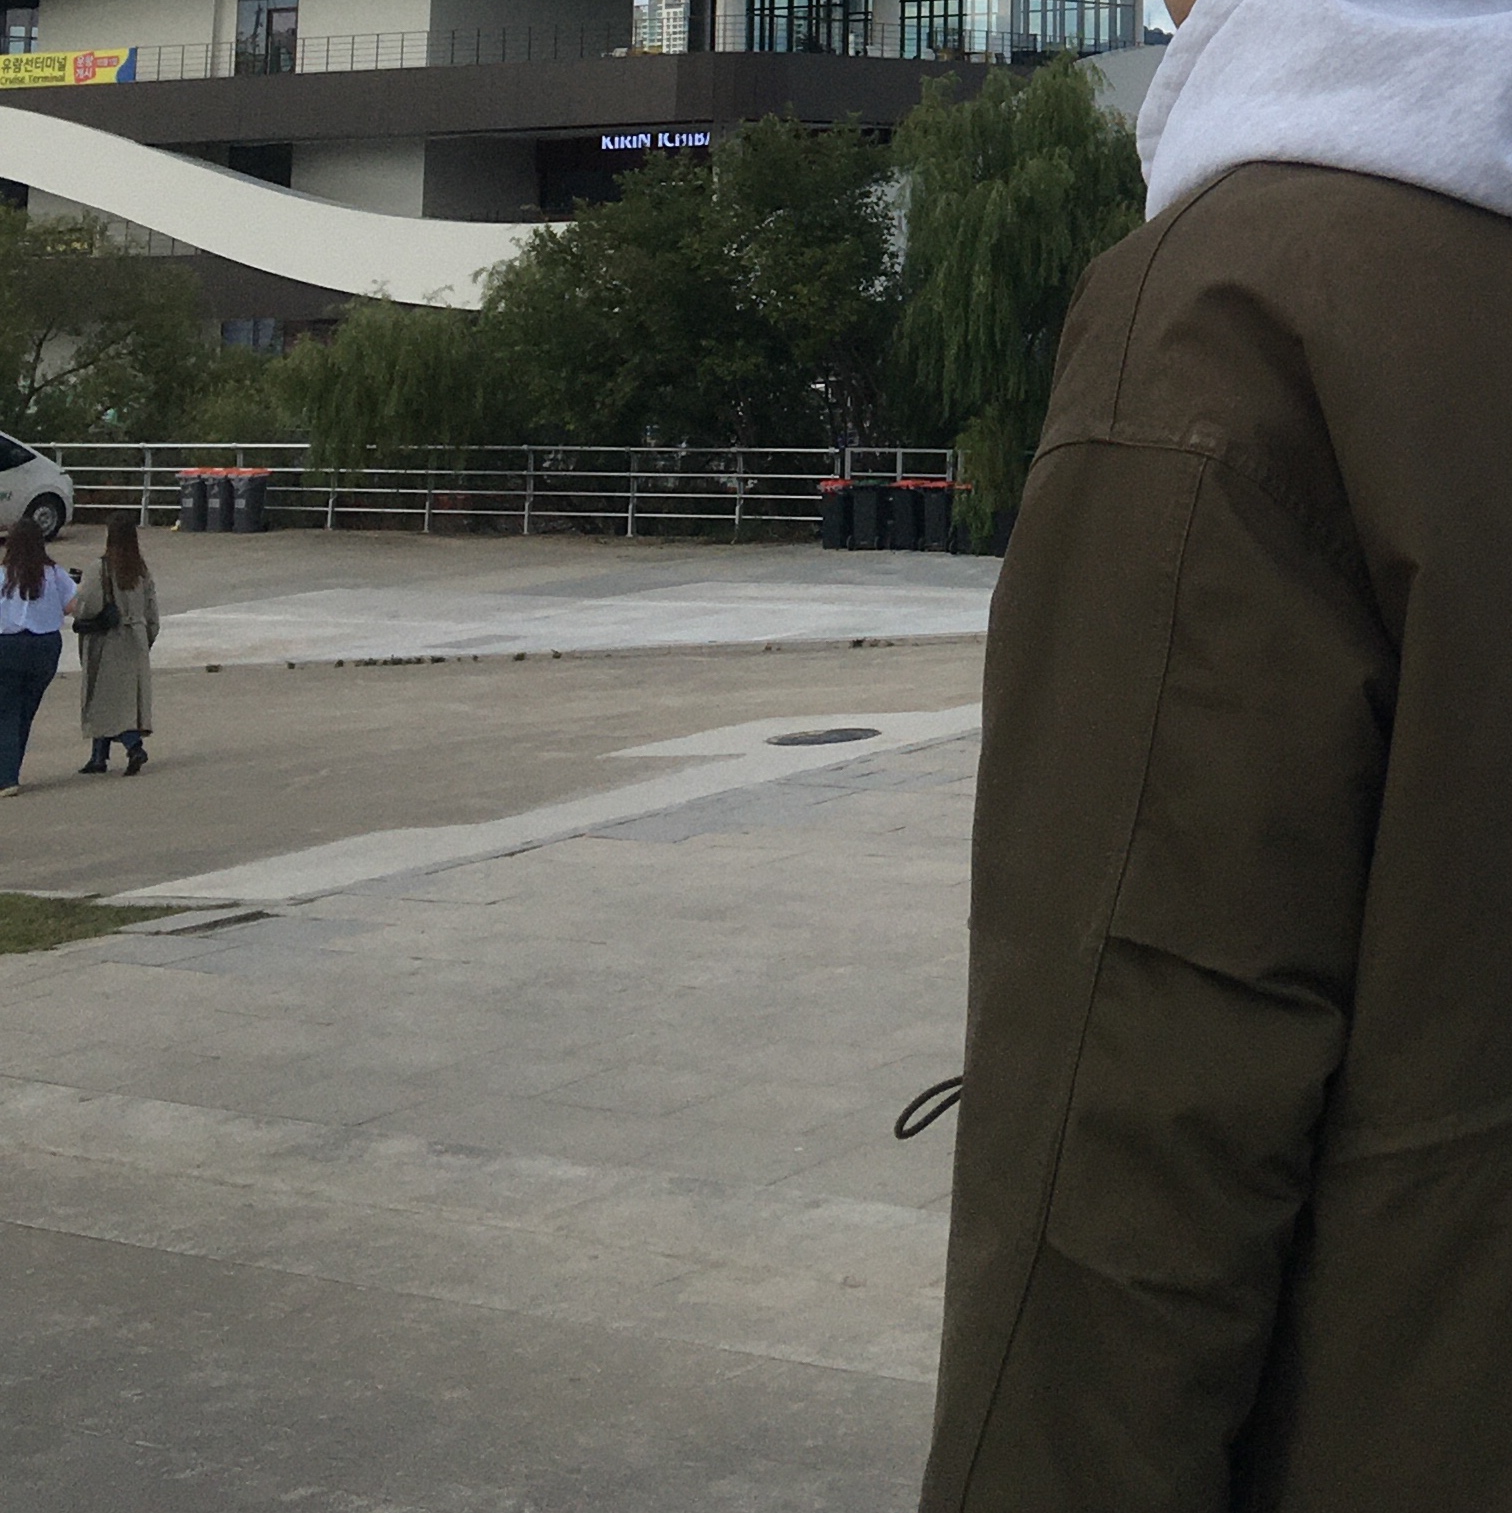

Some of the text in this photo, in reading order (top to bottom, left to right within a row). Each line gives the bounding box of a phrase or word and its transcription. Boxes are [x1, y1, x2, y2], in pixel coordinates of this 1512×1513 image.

[1, 55, 68, 74] 유람선터미널
[0, 73, 66, 86] Cruise Terminal
